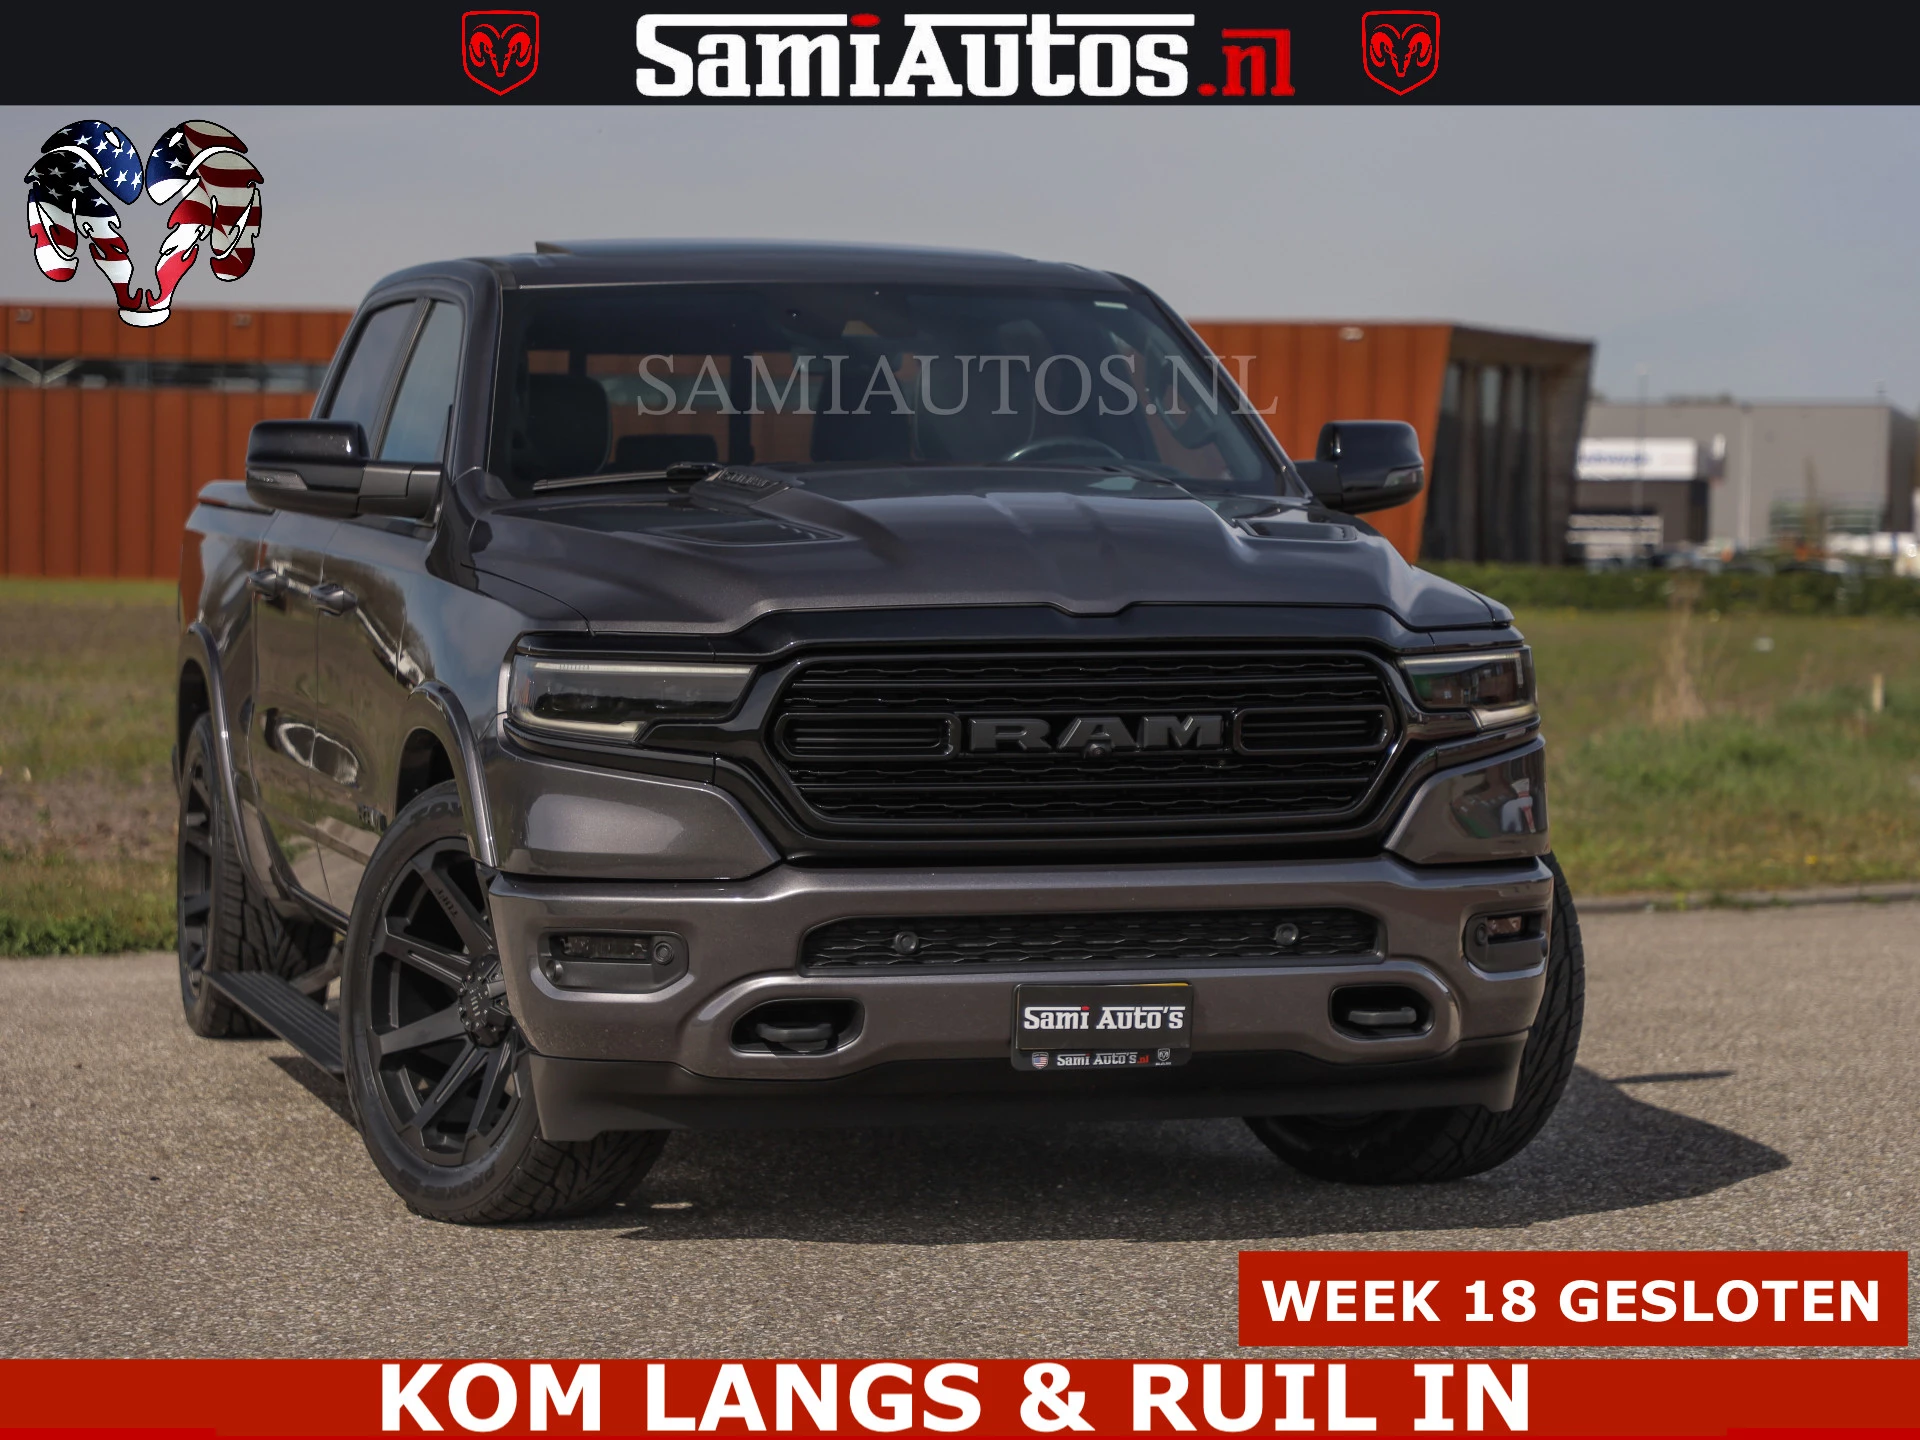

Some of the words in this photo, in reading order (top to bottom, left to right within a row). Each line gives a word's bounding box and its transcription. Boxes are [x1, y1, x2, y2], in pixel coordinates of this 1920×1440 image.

[968, 714, 1224, 752] RAM
[1024, 1006, 1090, 1030] Sami
[1096, 1006, 1186, 1030] Auto's
[1057, 1053, 1090, 1067] Sami
